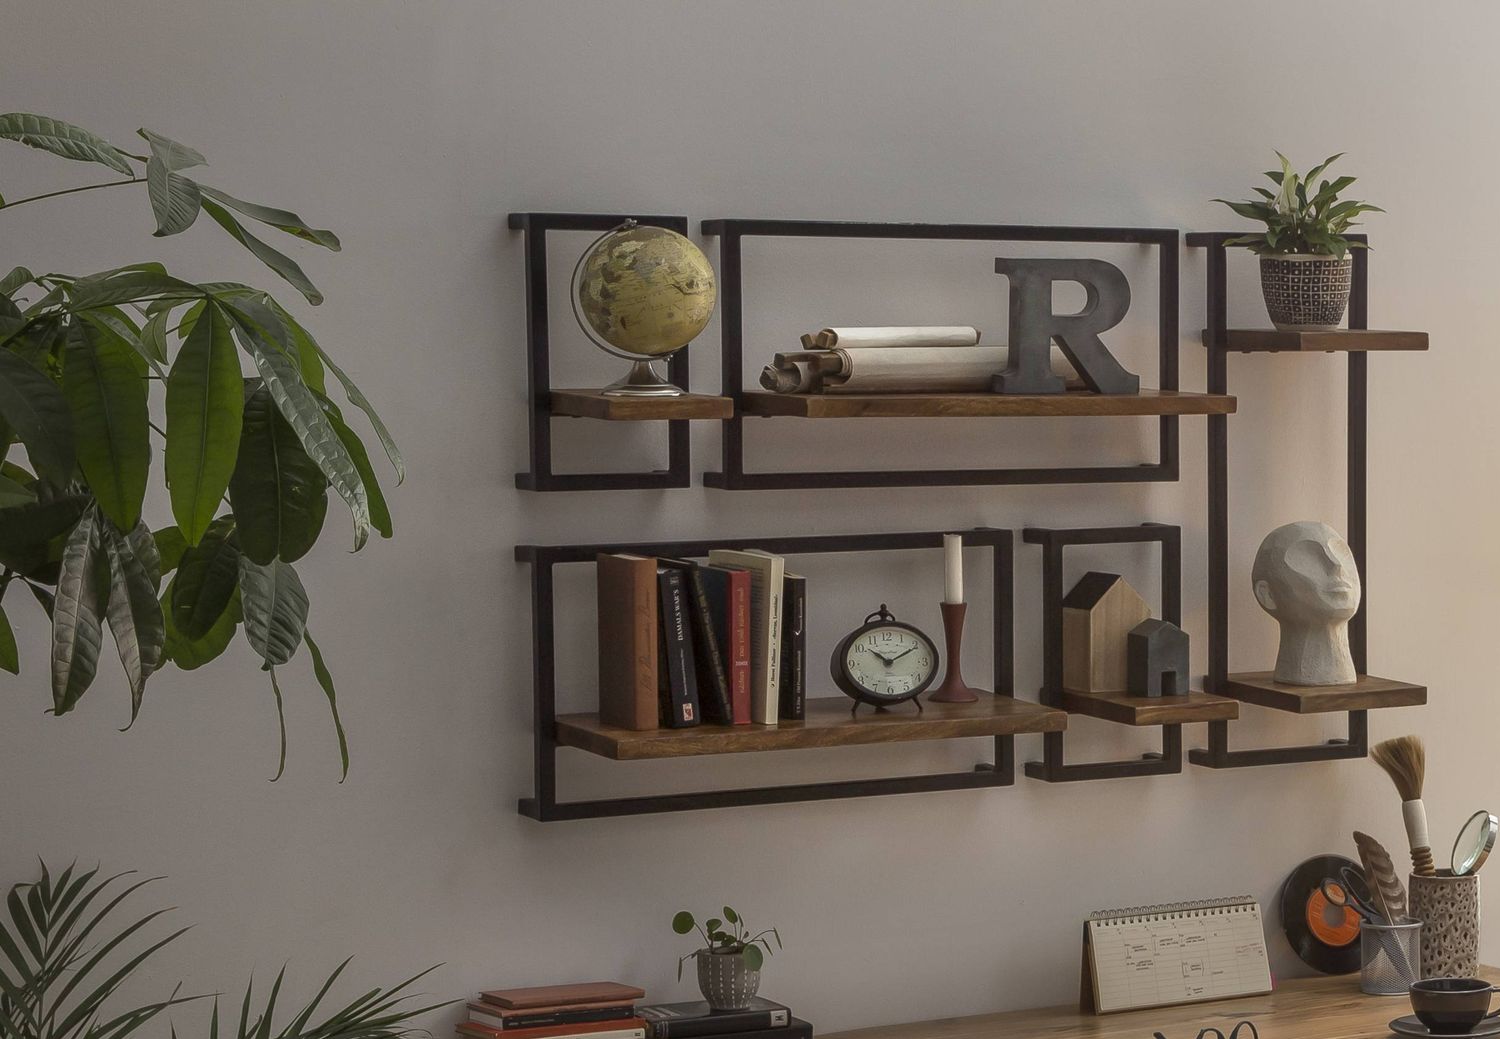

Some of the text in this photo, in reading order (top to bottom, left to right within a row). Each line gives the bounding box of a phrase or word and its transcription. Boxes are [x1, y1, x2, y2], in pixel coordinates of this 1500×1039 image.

[992, 257, 1139, 395] R
[675, 612, 684, 641] DAMALS
[868, 636, 876, 645] 11
[882, 632, 892, 641] 12
[900, 634, 903, 643] 1
[855, 643, 864, 653] 10
[912, 641, 918, 649] 2
[848, 660, 855, 669] 9
[922, 657, 928, 666] 3
[858, 675, 865, 685] 8
[915, 674, 921, 683] 4
[872, 683, 878, 693] 7
[887, 686, 894, 694] 6
[903, 682, 909, 691] 5
